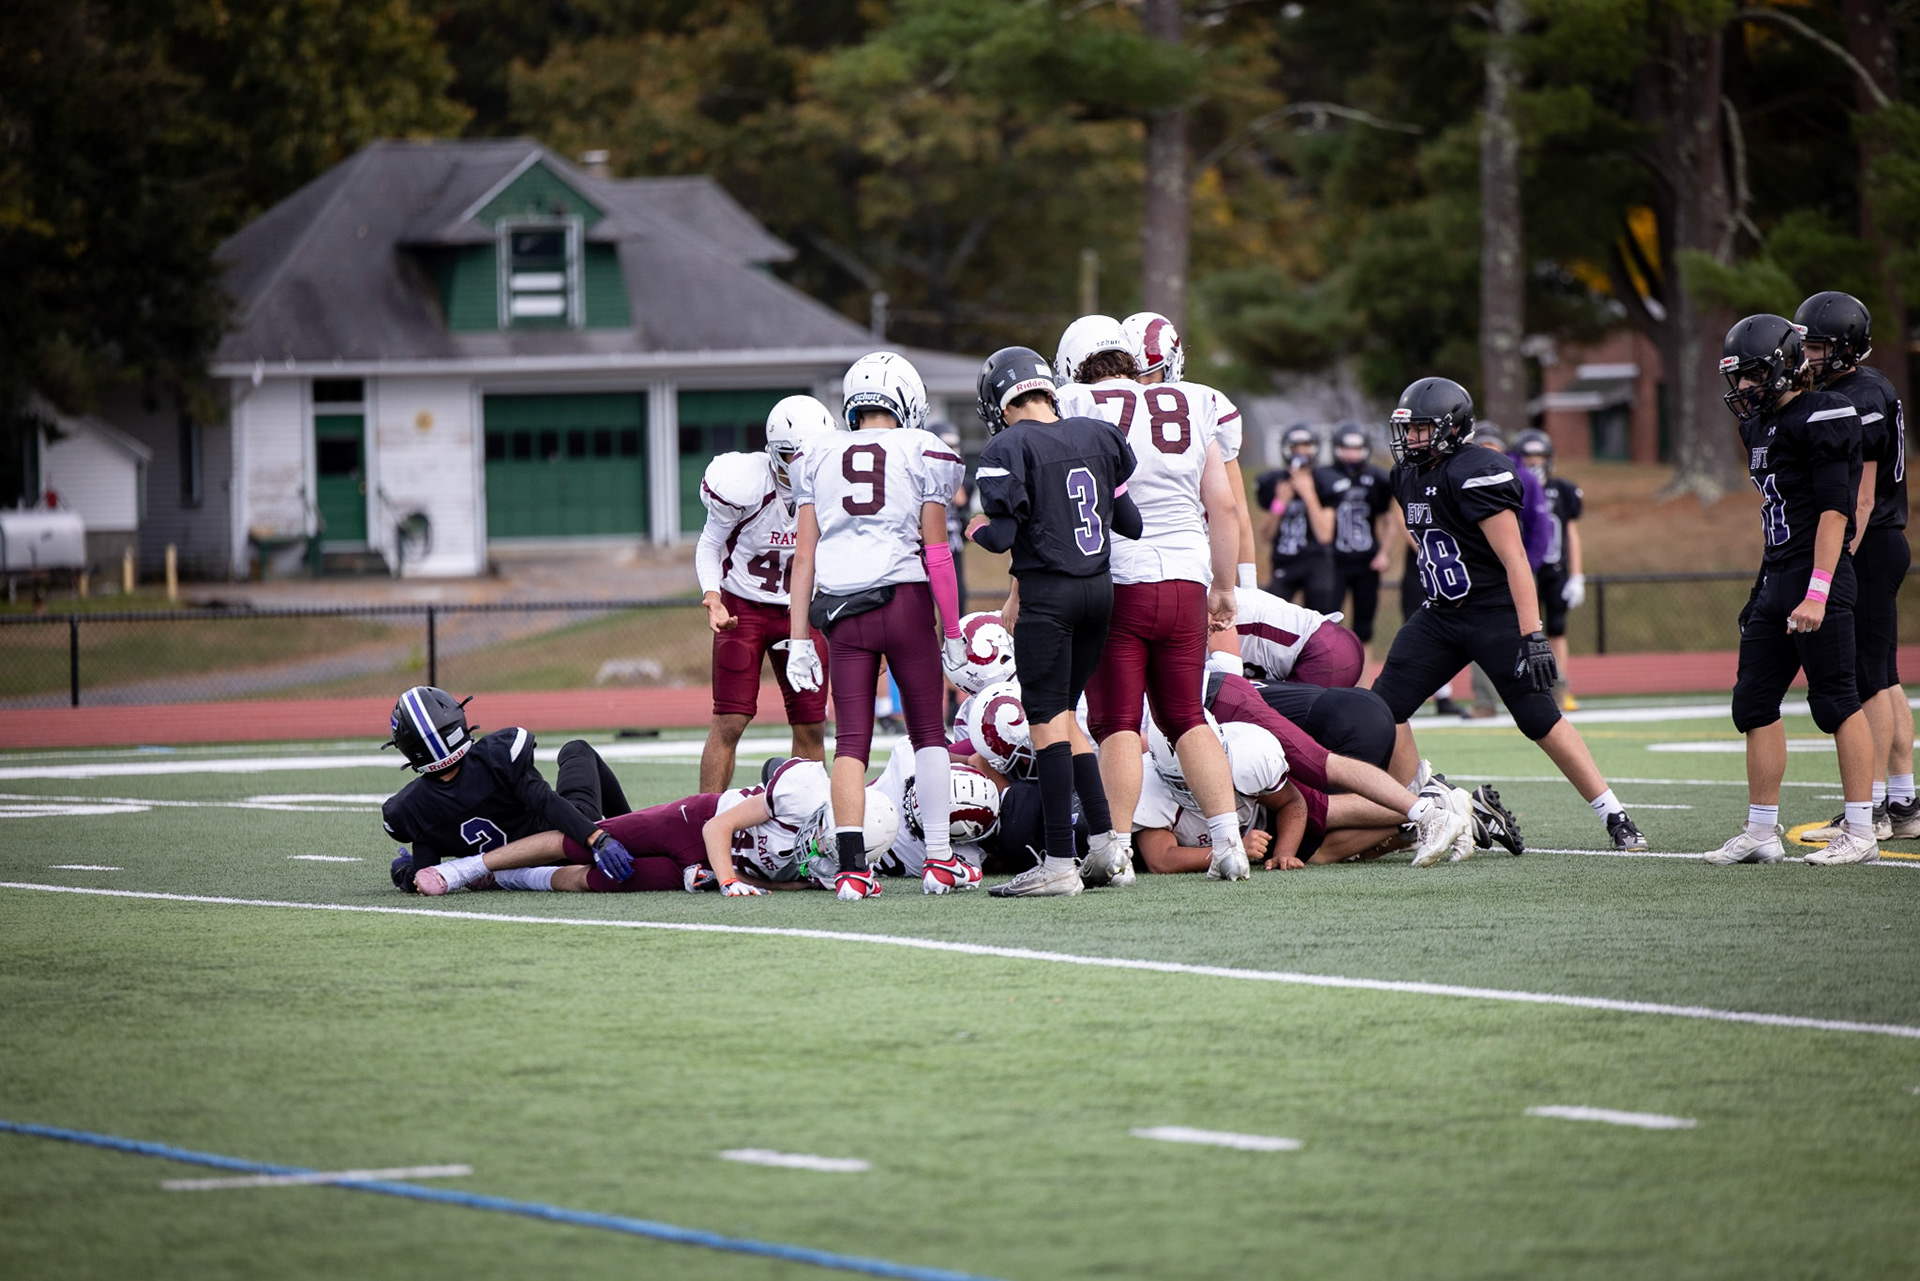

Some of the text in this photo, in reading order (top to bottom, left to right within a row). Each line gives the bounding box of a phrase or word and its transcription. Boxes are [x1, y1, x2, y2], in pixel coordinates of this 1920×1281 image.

[853, 392, 881, 401] schutt
[1090, 386, 1191, 454] 78
[842, 443, 886, 516] 9
[1066, 467, 1104, 556] 3
[428, 749, 465, 771] Riddell
[757, 835, 779, 871] RAMS
